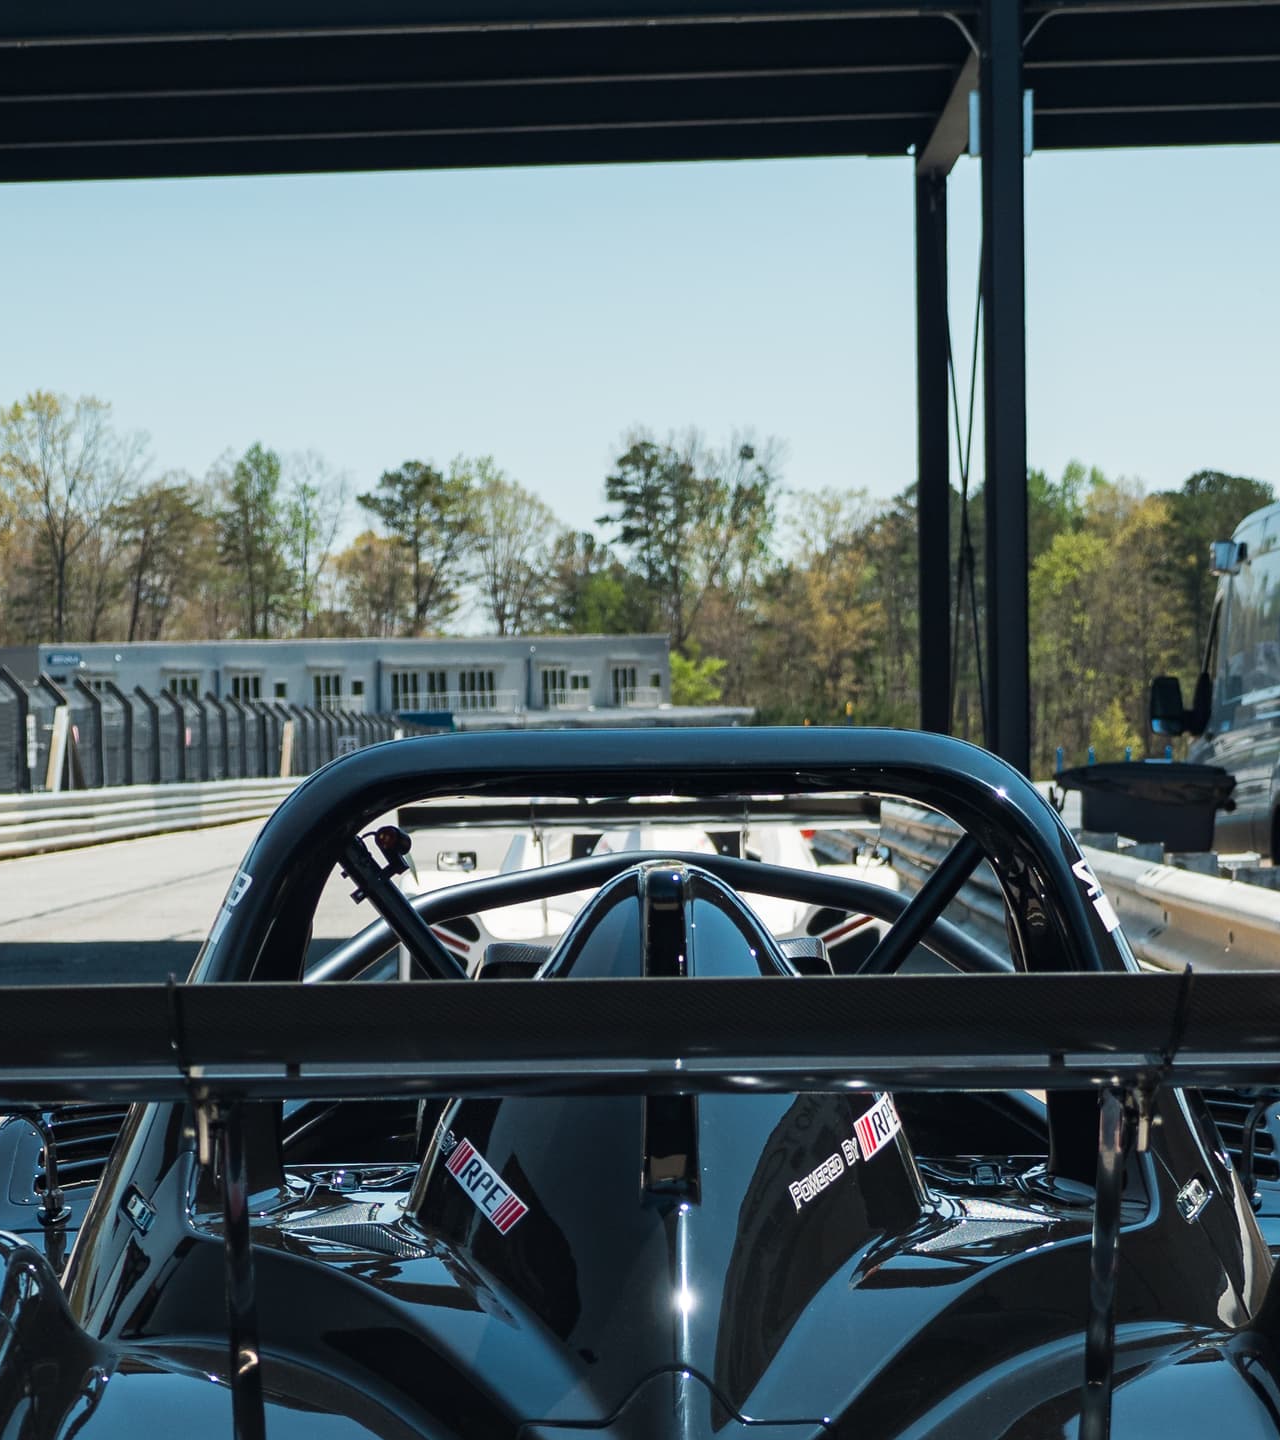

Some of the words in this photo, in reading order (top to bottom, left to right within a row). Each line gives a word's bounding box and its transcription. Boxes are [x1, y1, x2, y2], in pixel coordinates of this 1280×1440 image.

[841, 1137, 860, 1167] BY
[872, 1098, 898, 1143] RPE
[459, 1158, 508, 1214] RPE
